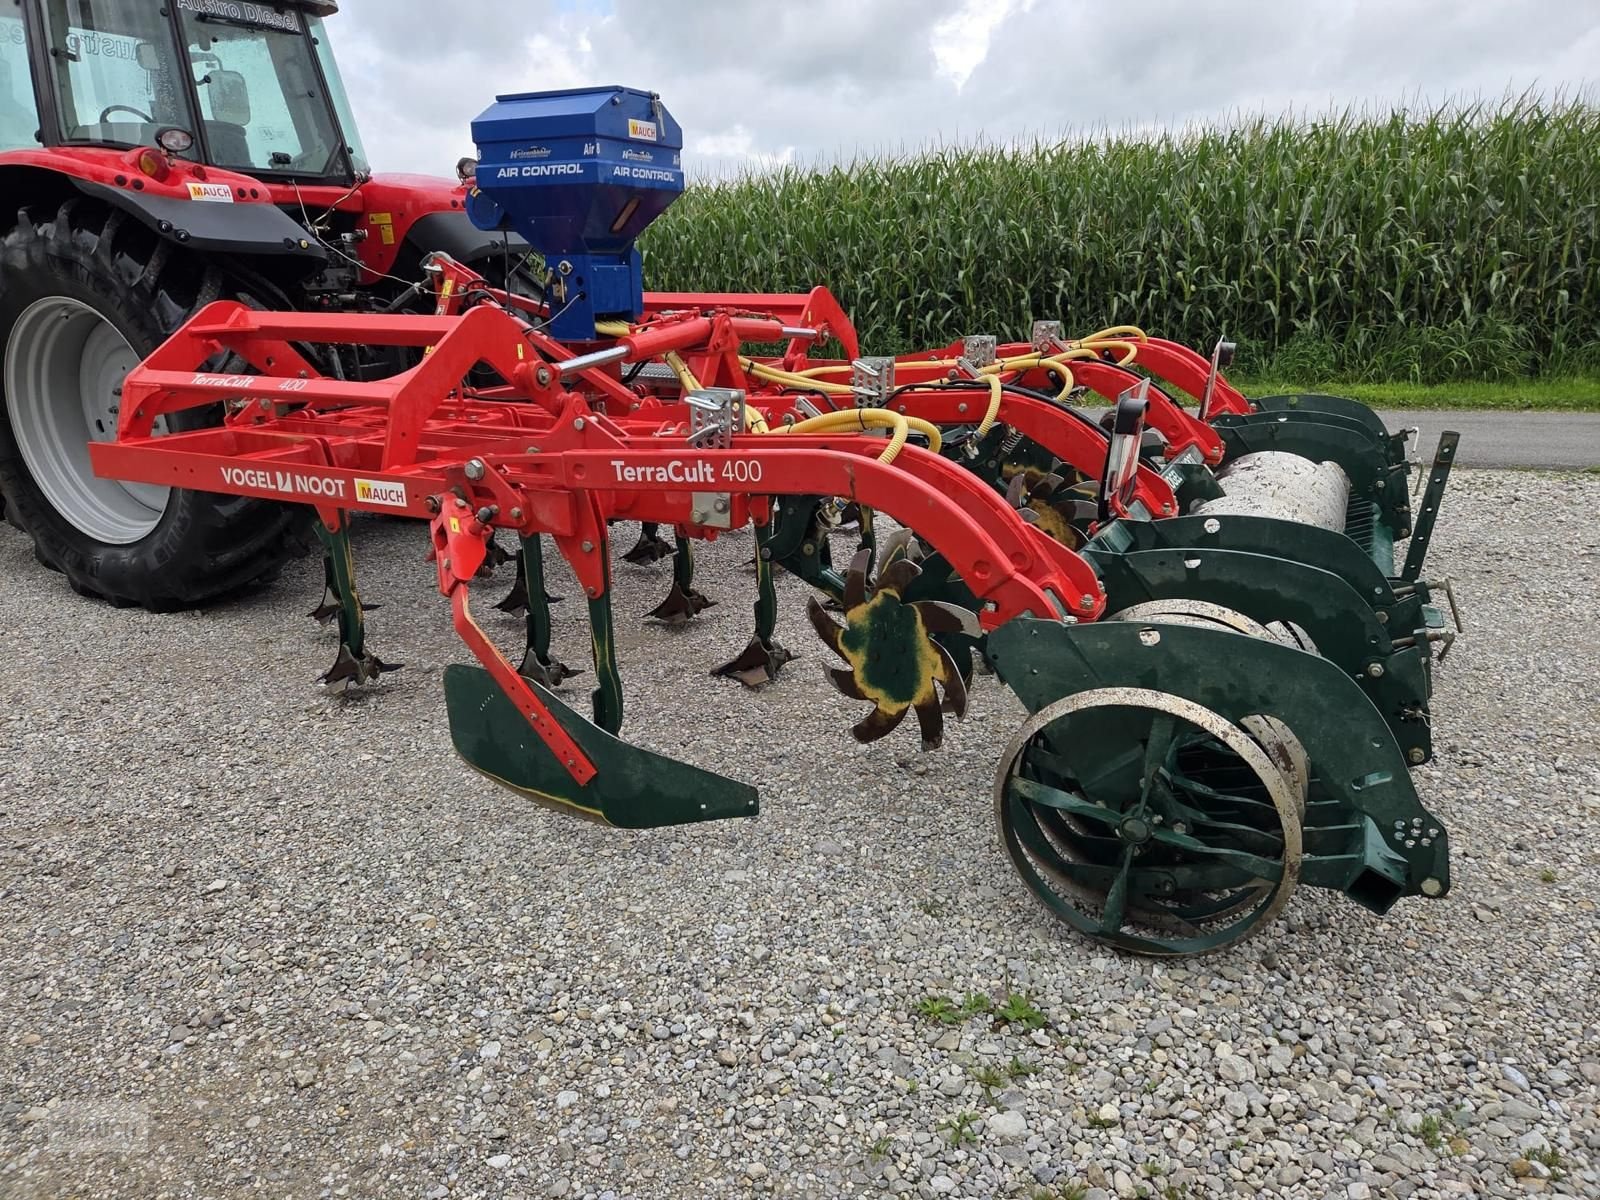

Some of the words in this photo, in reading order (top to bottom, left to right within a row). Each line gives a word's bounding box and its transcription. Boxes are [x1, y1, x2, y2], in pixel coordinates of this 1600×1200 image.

[243, 2, 300, 32] Diesel
[631, 125, 657, 138] MAUCH
[583, 142, 595, 156] Air
[497, 167, 518, 178] AIR
[522, 163, 584, 177] CONTROL
[613, 165, 631, 177] AIR
[631, 167, 675, 182] CONTROL
[191, 186, 231, 198] MAUCH
[190, 373, 255, 388] TerraCult
[277, 378, 307, 391] 400
[610, 460, 715, 483] TerraCult
[721, 460, 763, 482] 400
[220, 467, 277, 490] VOGEL
[295, 475, 346, 497] NOOT
[361, 485, 405, 504] MAUCH
